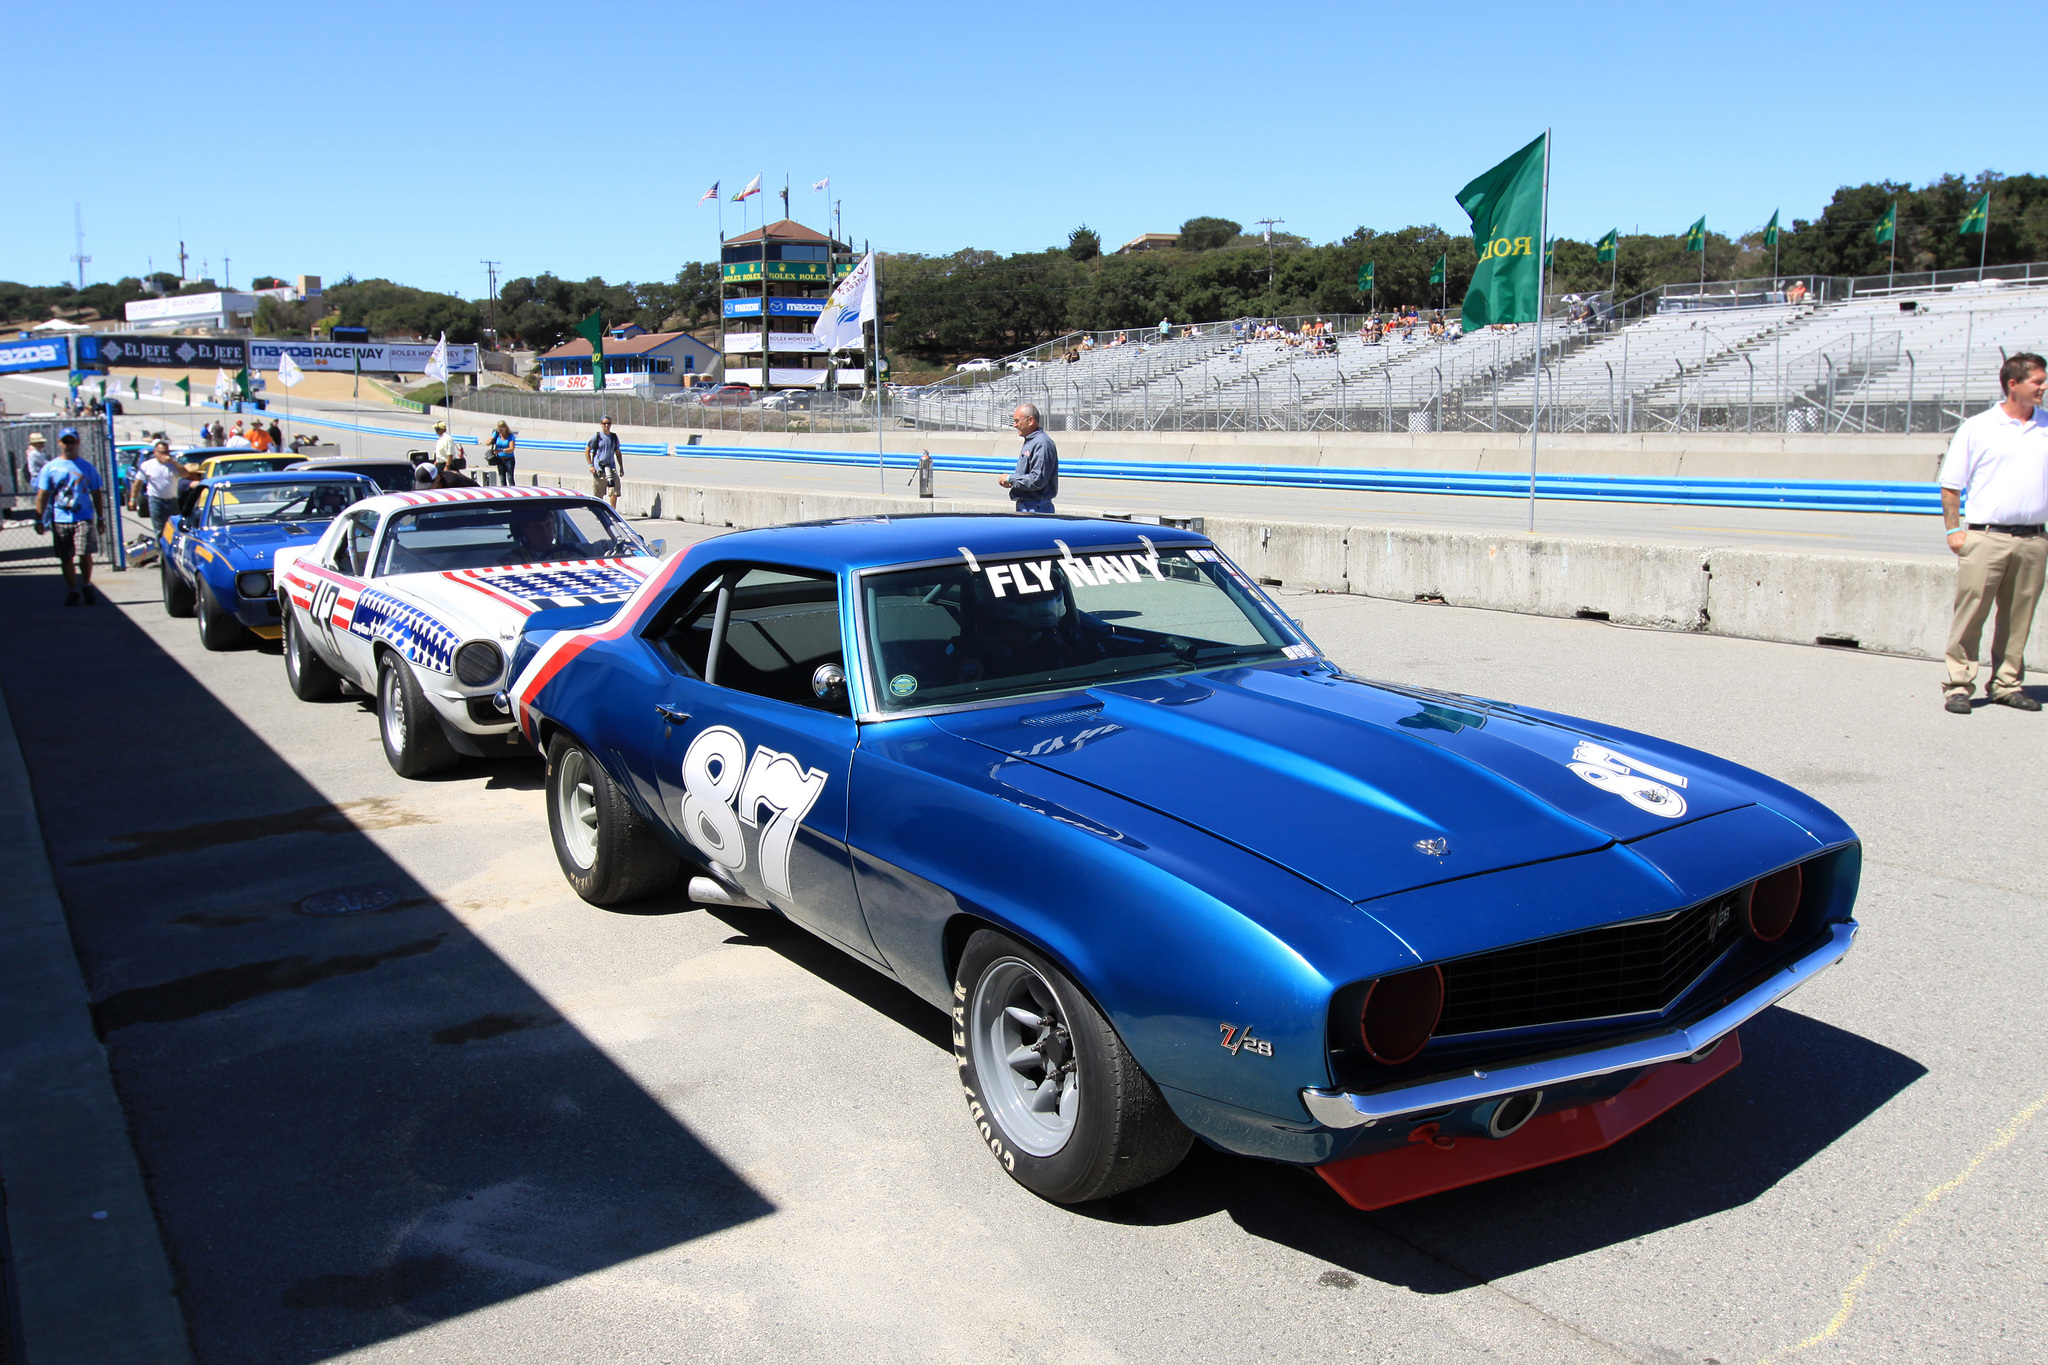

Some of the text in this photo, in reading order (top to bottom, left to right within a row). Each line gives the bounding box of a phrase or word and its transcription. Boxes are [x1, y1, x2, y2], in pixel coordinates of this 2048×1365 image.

[769, 272, 796, 280] ROLEX
[735, 303, 760, 312] mazda
[786, 303, 823, 311] mazda
[0, 345, 57, 365] azda
[124, 343, 170, 359] EL JEFE
[198, 344, 241, 360] EL JEFE
[314, 347, 384, 359] RACEWAY
[391, 349, 416, 357] ROLEX
[252, 357, 281, 365] LAGUN
[567, 376, 588, 388] SRC
[985, 554, 1167, 598] FLY NAVY
[1566, 740, 1688, 818] 87
[682, 725, 829, 904] 87
[1220, 1022, 1273, 1057] Z/28
